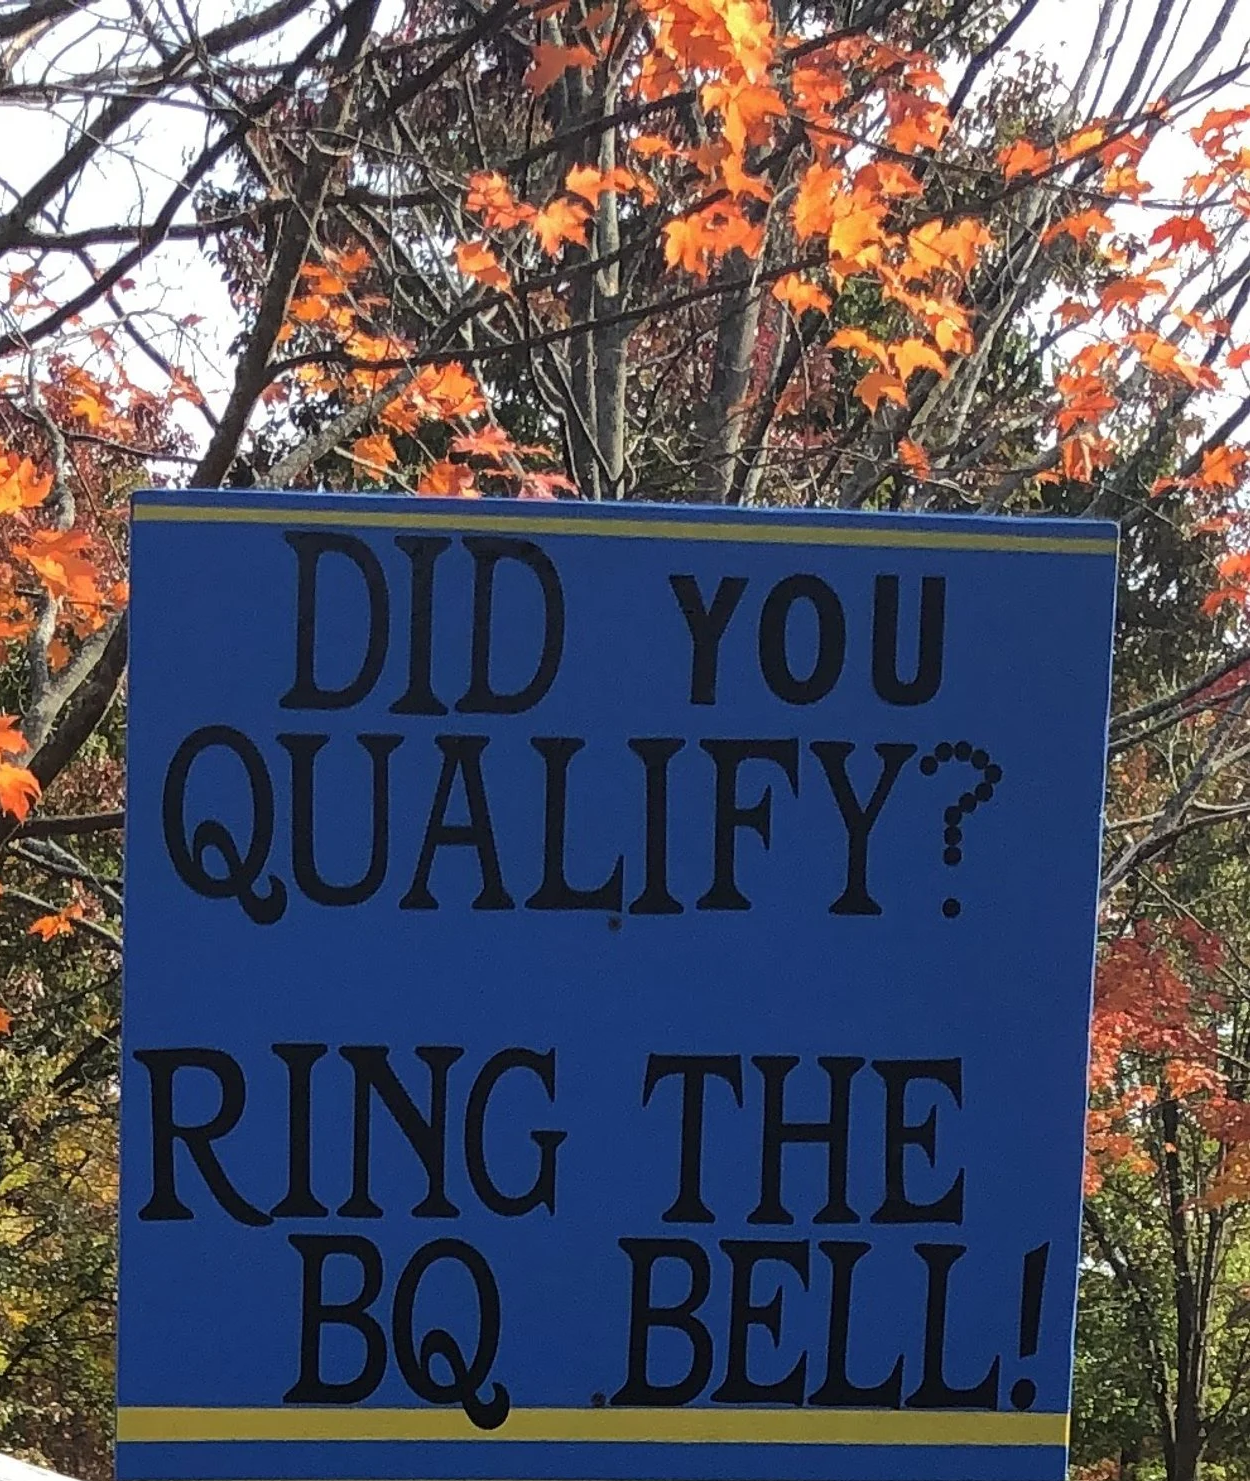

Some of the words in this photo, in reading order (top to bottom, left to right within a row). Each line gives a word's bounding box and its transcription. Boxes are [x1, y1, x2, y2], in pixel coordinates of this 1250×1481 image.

[279, 531, 565, 716] DID
[669, 573, 946, 705] YOU
[162, 724, 1002, 925] QUALIFY?
[132, 1043, 568, 1227] RING
[641, 1053, 965, 1225] THE
[282, 1233, 510, 1430] BQ
[610, 1237, 1050, 1412] BELL!
